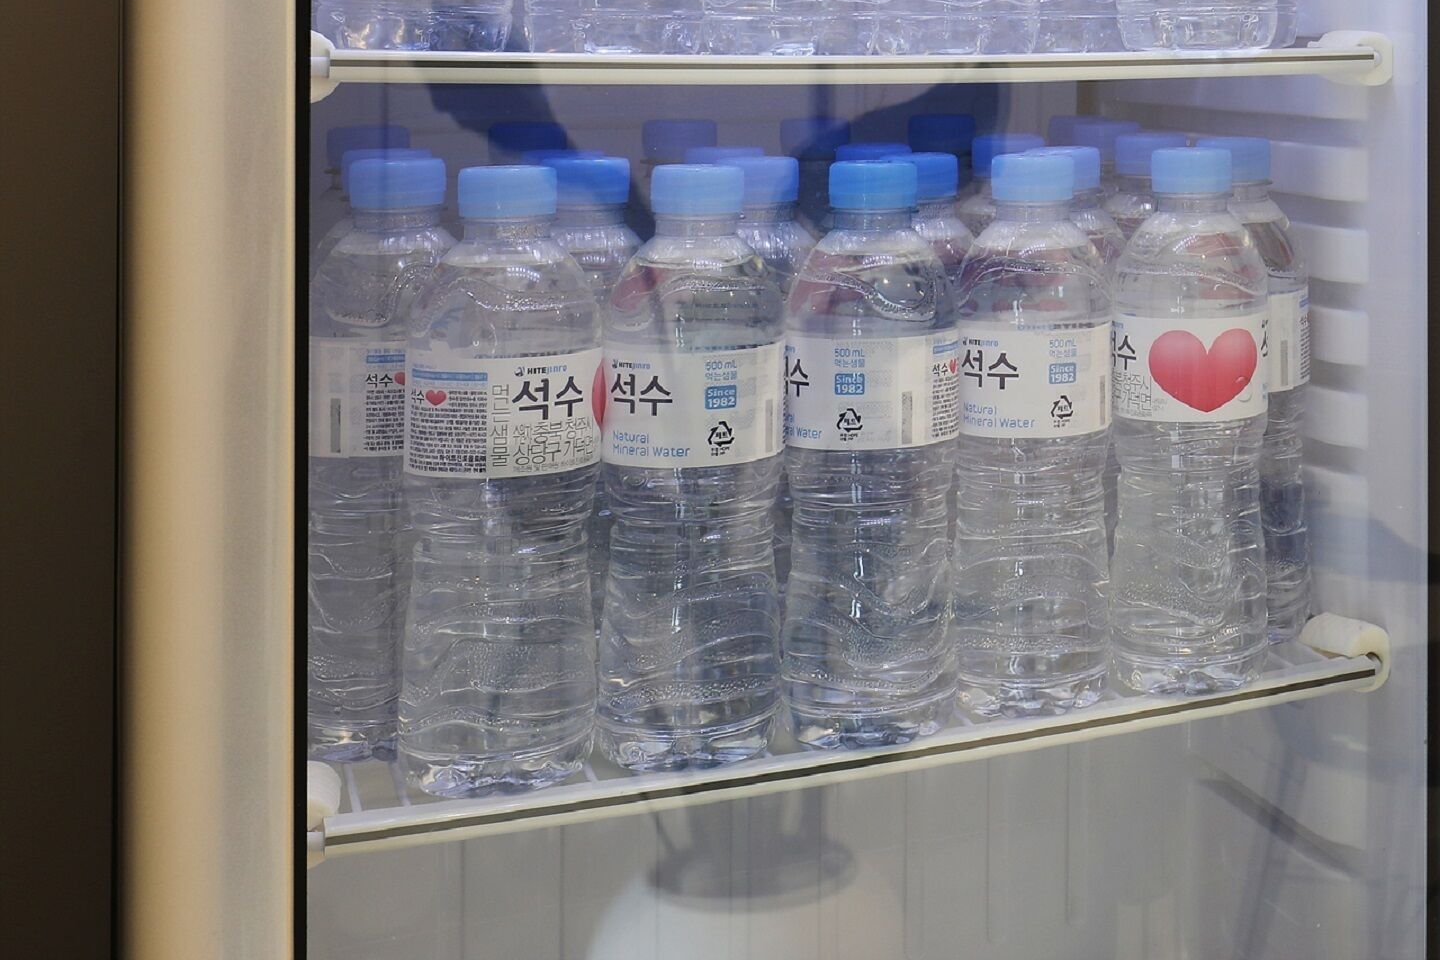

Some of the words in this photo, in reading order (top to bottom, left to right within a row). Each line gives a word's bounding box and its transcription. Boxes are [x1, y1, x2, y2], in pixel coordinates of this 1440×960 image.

[834, 348, 850, 358] 500
[851, 348, 865, 358] mL
[705, 361, 722, 371] 500
[724, 360, 737, 369] mL
[932, 363, 948, 376] 석수
[961, 349, 1019, 390] 석수
[1050, 365, 1074, 373] Since
[365, 373, 394, 388] 석수
[1050, 373, 1074, 382] 1982
[611, 373, 673, 416] 석수
[708, 389, 736, 397] Since
[836, 384, 863, 394] 1982
[512, 376, 583, 420] 석수
[708, 398, 736, 408] 1982
[963, 402, 997, 415] Natural
[491, 384, 511, 467] 먹는샘물
[963, 414, 997, 427] Mineral
[1000, 418, 1035, 428] Water
[532, 421, 566, 444] 충북
[613, 431, 649, 444] Natural
[797, 428, 822, 439] Water
[513, 441, 562, 466] 상당구
[613, 445, 649, 457] Mineral
[652, 447, 690, 458] Water
